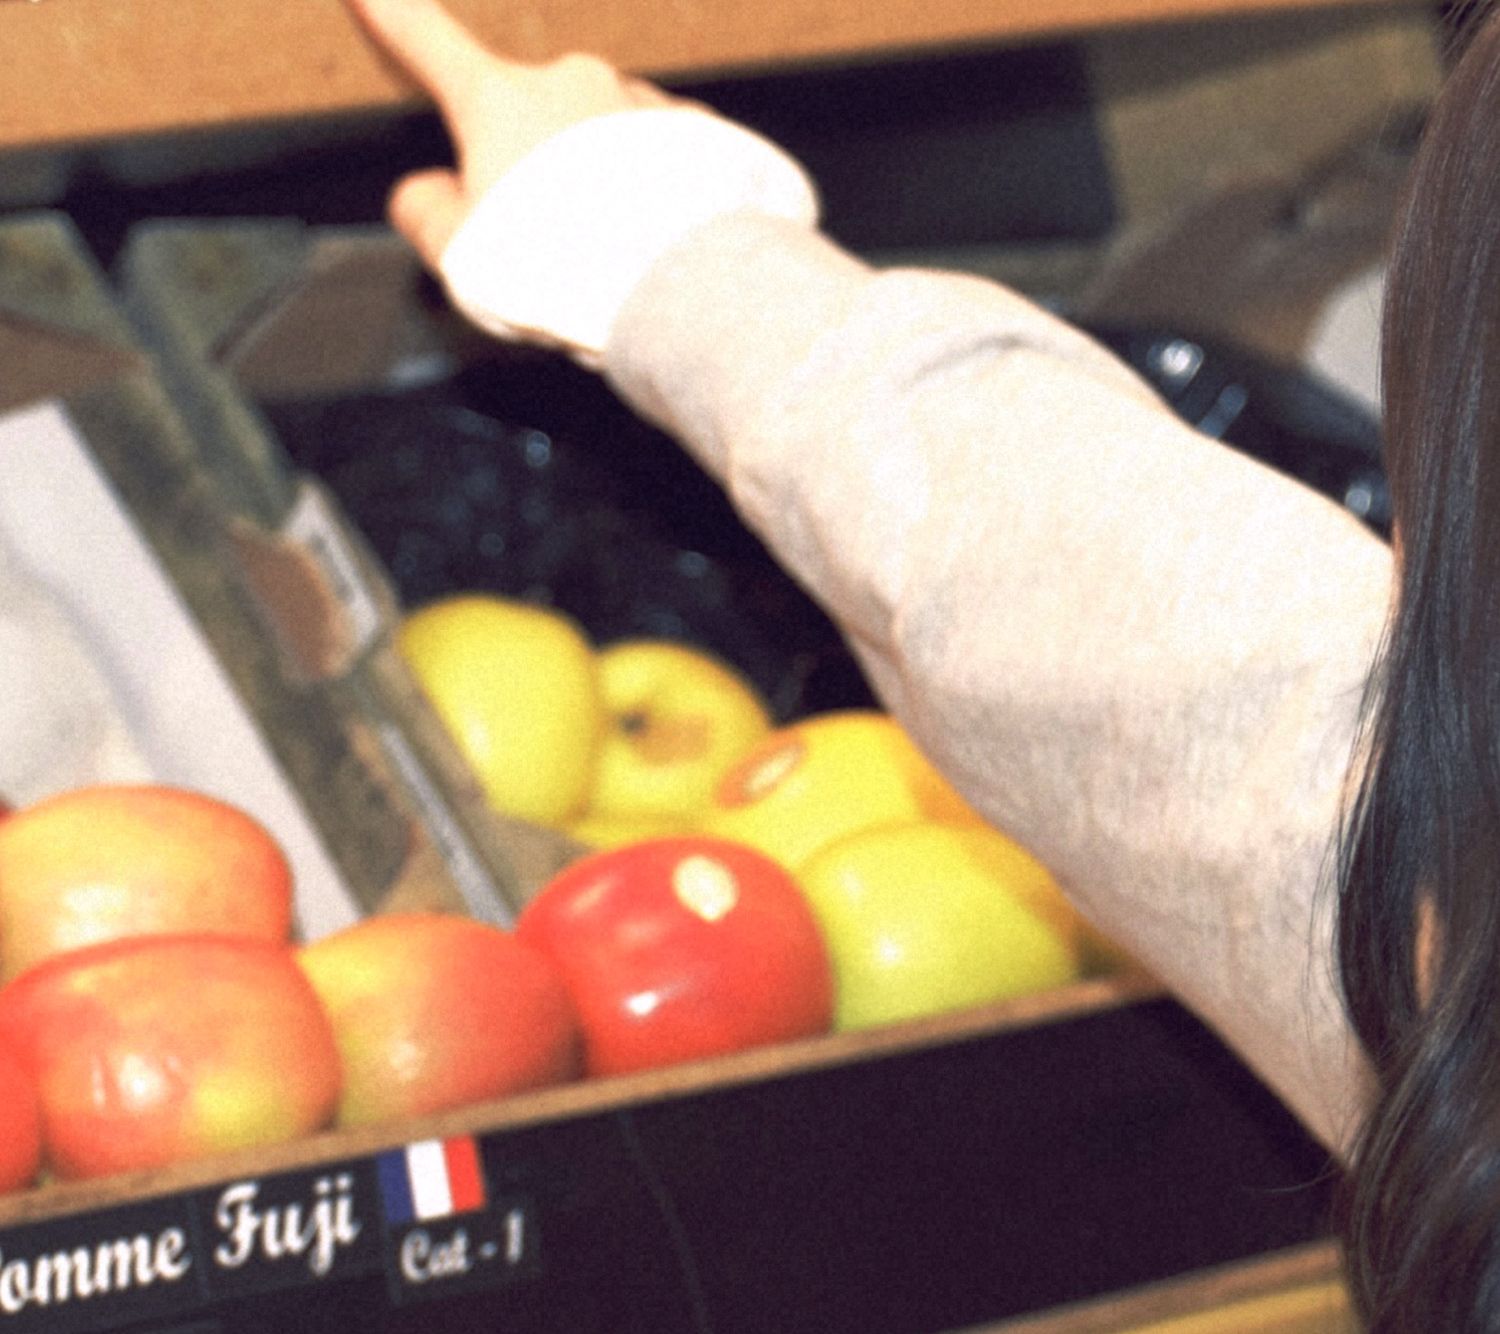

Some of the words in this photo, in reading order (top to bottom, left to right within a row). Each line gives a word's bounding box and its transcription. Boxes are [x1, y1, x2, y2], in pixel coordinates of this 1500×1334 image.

[0, 1225, 192, 1314] omme
[214, 1172, 363, 1279] Fuji
[401, 1226, 472, 1284] Cat
